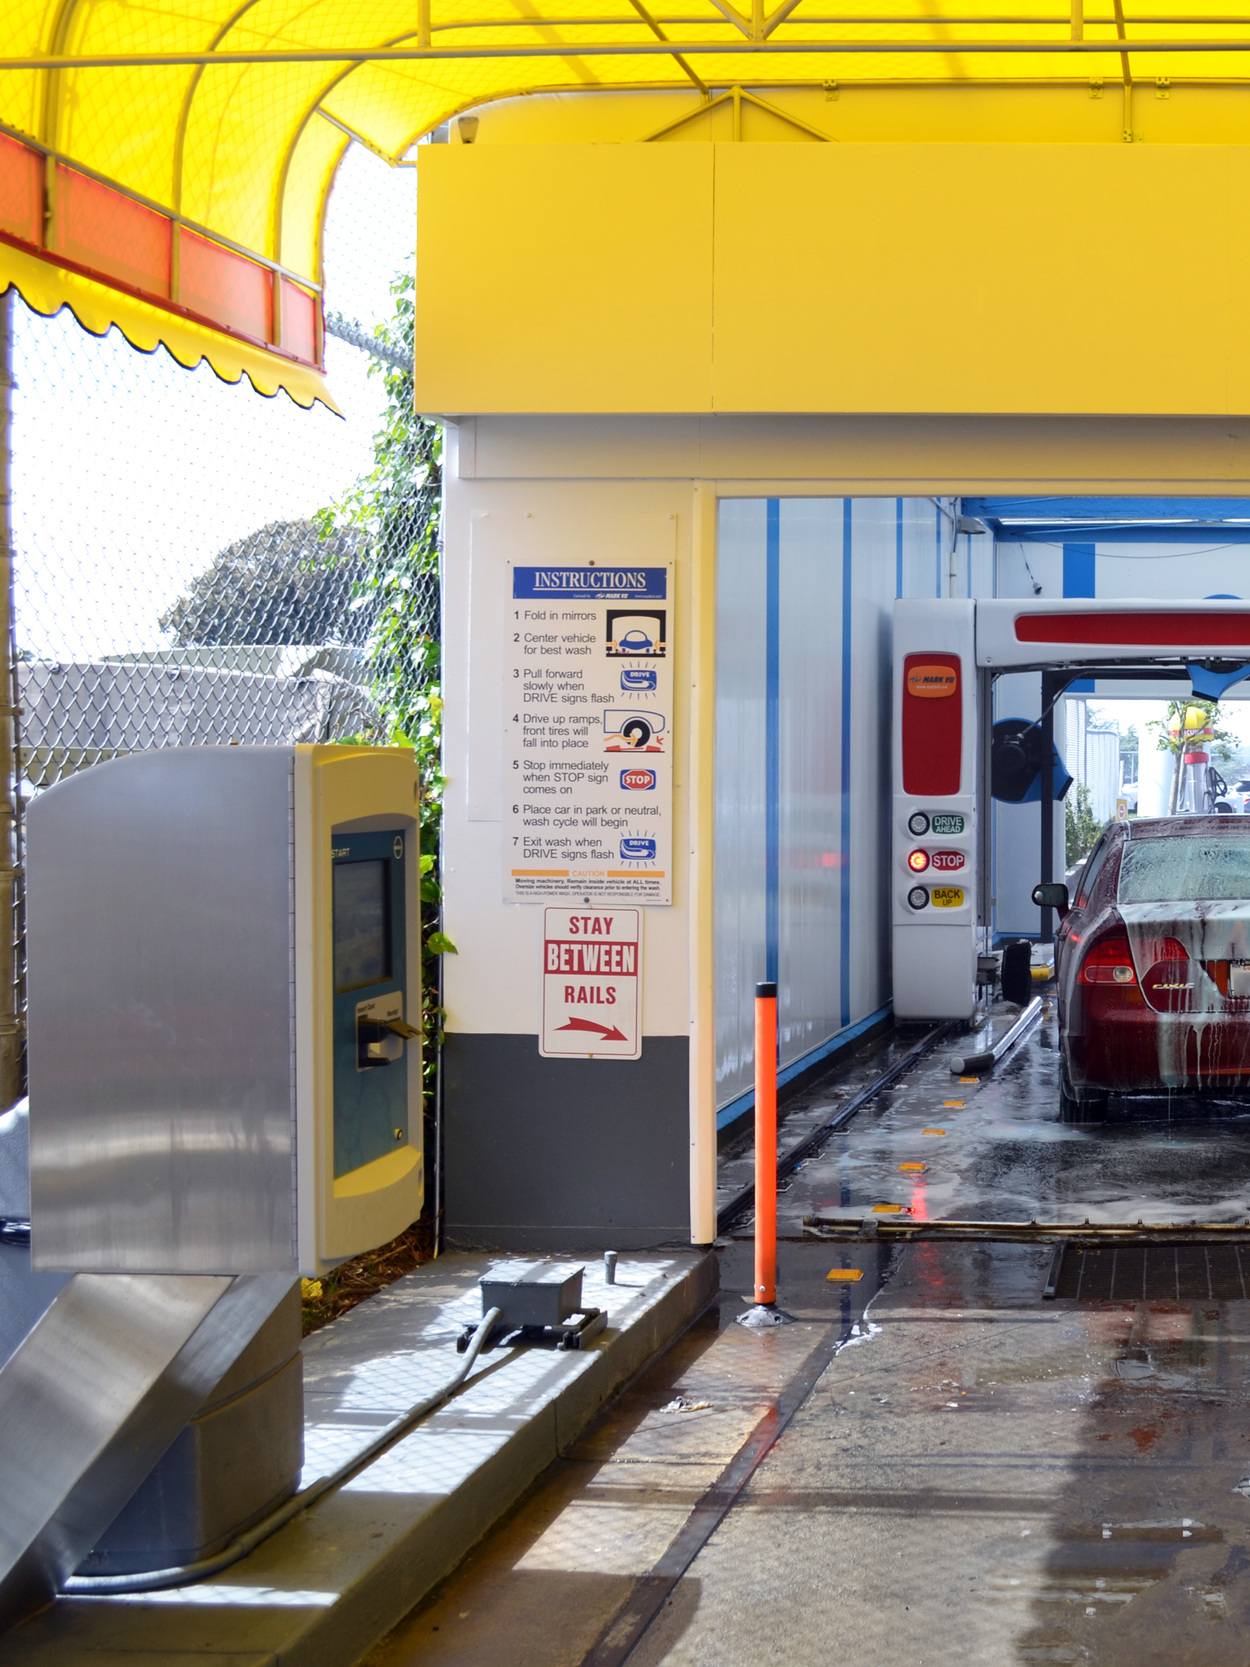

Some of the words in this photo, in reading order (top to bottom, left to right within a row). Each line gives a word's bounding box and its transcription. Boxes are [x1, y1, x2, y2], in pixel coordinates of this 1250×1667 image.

[535, 572, 646, 588] INSTRUCTIONS
[514, 611, 519, 619] 1
[525, 611, 546, 620] Fold
[550, 611, 558, 620] in
[562, 611, 596, 620] mirrors
[514, 633, 520, 642] 2
[524, 633, 558, 642] Center
[562, 633, 596, 642] vehicle
[524, 645, 537, 654] for
[541, 645, 561, 654] best
[565, 646, 591, 654] wash
[513, 669, 519, 678] 3
[524, 669, 542, 678] Pull
[546, 669, 583, 678] forward
[523, 681, 554, 692] slowly
[557, 682, 584, 690] when
[523, 693, 558, 702] DRIVE
[561, 693, 587, 705] signs
[591, 693, 614, 703] flash
[513, 714, 519, 722] 4
[523, 714, 549, 723] Drive
[553, 716, 565, 725] up
[569, 716, 602, 725] ramps,
[523, 726, 545, 735] front
[549, 726, 569, 735] tires
[573, 726, 588, 735] will
[523, 738, 536, 747] fall
[541, 738, 558, 747] into
[562, 739, 588, 749] place
[513, 761, 519, 769] 5
[523, 760, 546, 771] Stop
[549, 761, 609, 772] immediately
[523, 773, 550, 782] when
[554, 773, 584, 782] STOP
[588, 773, 608, 784] sign
[626, 776, 650, 784] STOP
[523, 786, 556, 794] comes
[512, 805, 519, 813] 6
[523, 805, 551, 814] Place
[574, 805, 582, 814] in
[586, 806, 607, 816] park
[625, 806, 661, 816] neutral,
[523, 817, 549, 826] wash
[553, 817, 578, 828] cycle
[582, 818, 597, 826] will
[601, 818, 628, 829] begin
[935, 817, 962, 825] DRIVE
[513, 837, 519, 846] 7
[523, 837, 542, 846] Exit
[545, 838, 571, 846] wash
[575, 838, 602, 846] when
[332, 848, 350, 858] START
[523, 849, 557, 858] DRIVE
[561, 850, 587, 861] signs
[591, 850, 614, 859] flash
[934, 856, 963, 866] STOP
[935, 890, 960, 899] BACK
[569, 916, 613, 935] STAY
[547, 943, 634, 972] BETWEEN
[565, 986, 616, 1004] RAILS
